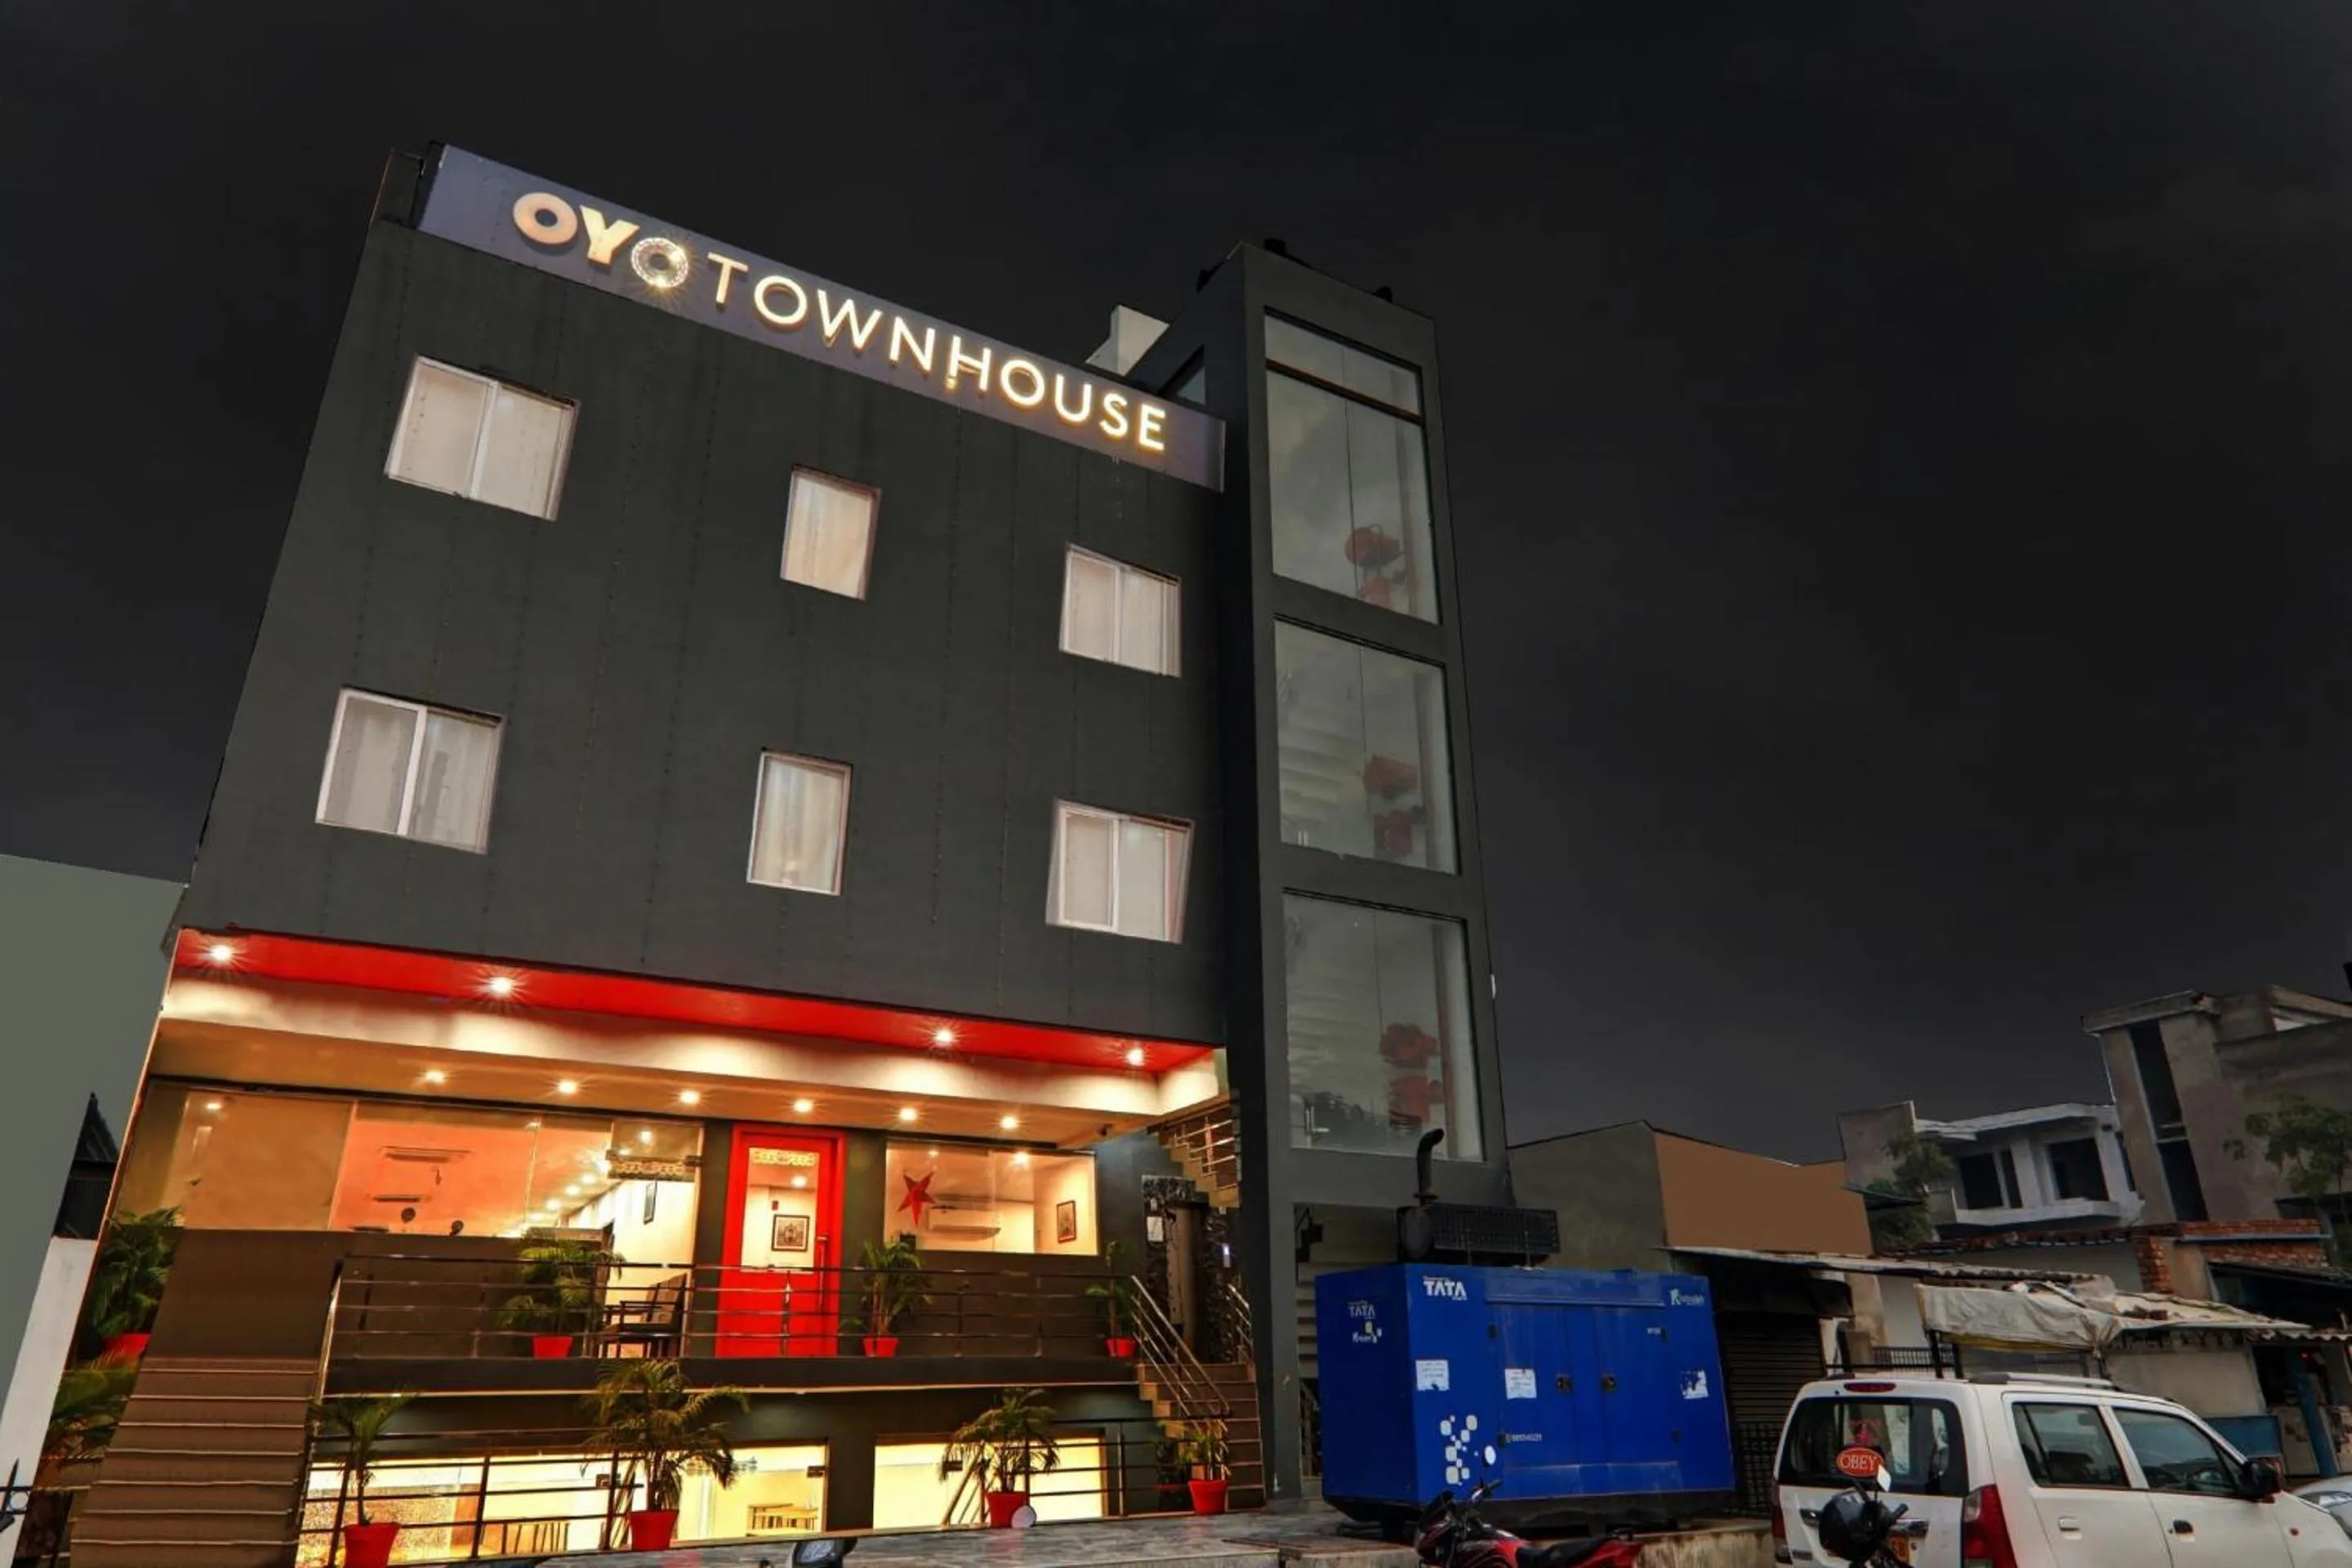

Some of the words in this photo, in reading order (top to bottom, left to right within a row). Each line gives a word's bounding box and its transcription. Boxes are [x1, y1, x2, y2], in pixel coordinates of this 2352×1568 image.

[511, 191, 690, 289] OYO
[707, 251, 1168, 452] TOWNHOUSE
[1423, 1280, 1468, 1298] TATA
[1348, 1304, 1376, 1318] TATA
[1840, 1454, 1878, 1469] OBEY
